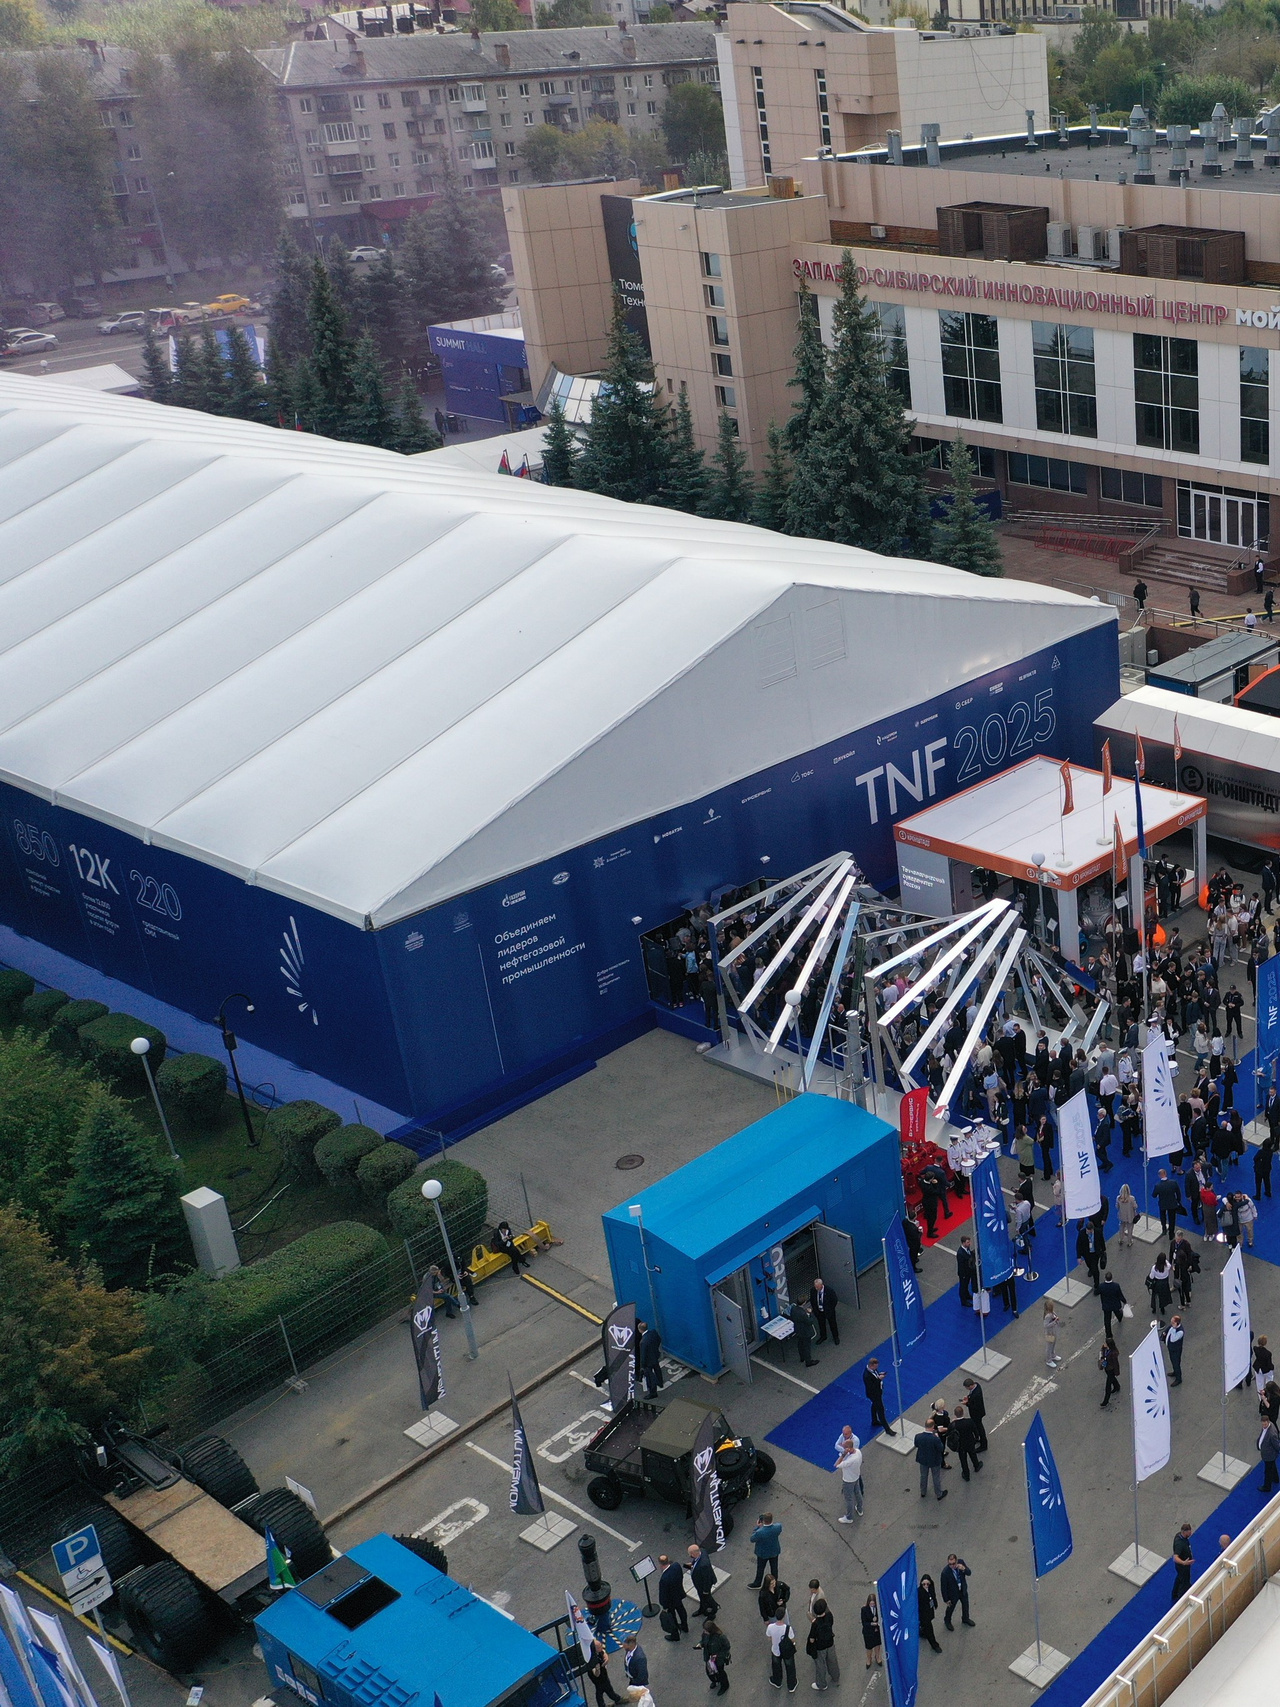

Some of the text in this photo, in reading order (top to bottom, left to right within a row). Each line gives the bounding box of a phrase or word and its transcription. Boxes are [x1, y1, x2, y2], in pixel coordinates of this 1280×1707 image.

[792, 258, 1228, 325] ЗАПАДО-СИБИРСКИЙ ИННОВАЦИОННЫЙ ЦЕНТР
[436, 336, 466, 350] SUMMIT
[855, 688, 1057, 825] TNF 2025
[1206, 777, 1280, 813] КРОНШТАДТ
[14, 819, 60, 867] 850
[68, 844, 120, 895] 12K
[130, 870, 182, 921] 220
[494, 912, 557, 945] Объединяем
[497, 934, 539, 959] лидеров
[499, 936, 566, 971] нефтегазовой
[502, 942, 586, 985] промышленности
[1267, 1005, 1278, 1029] TNF
[1079, 1151, 1091, 1179] TNF
[903, 1279, 916, 1310] TNF
[87, 1591, 105, 1605] МЕСТ
